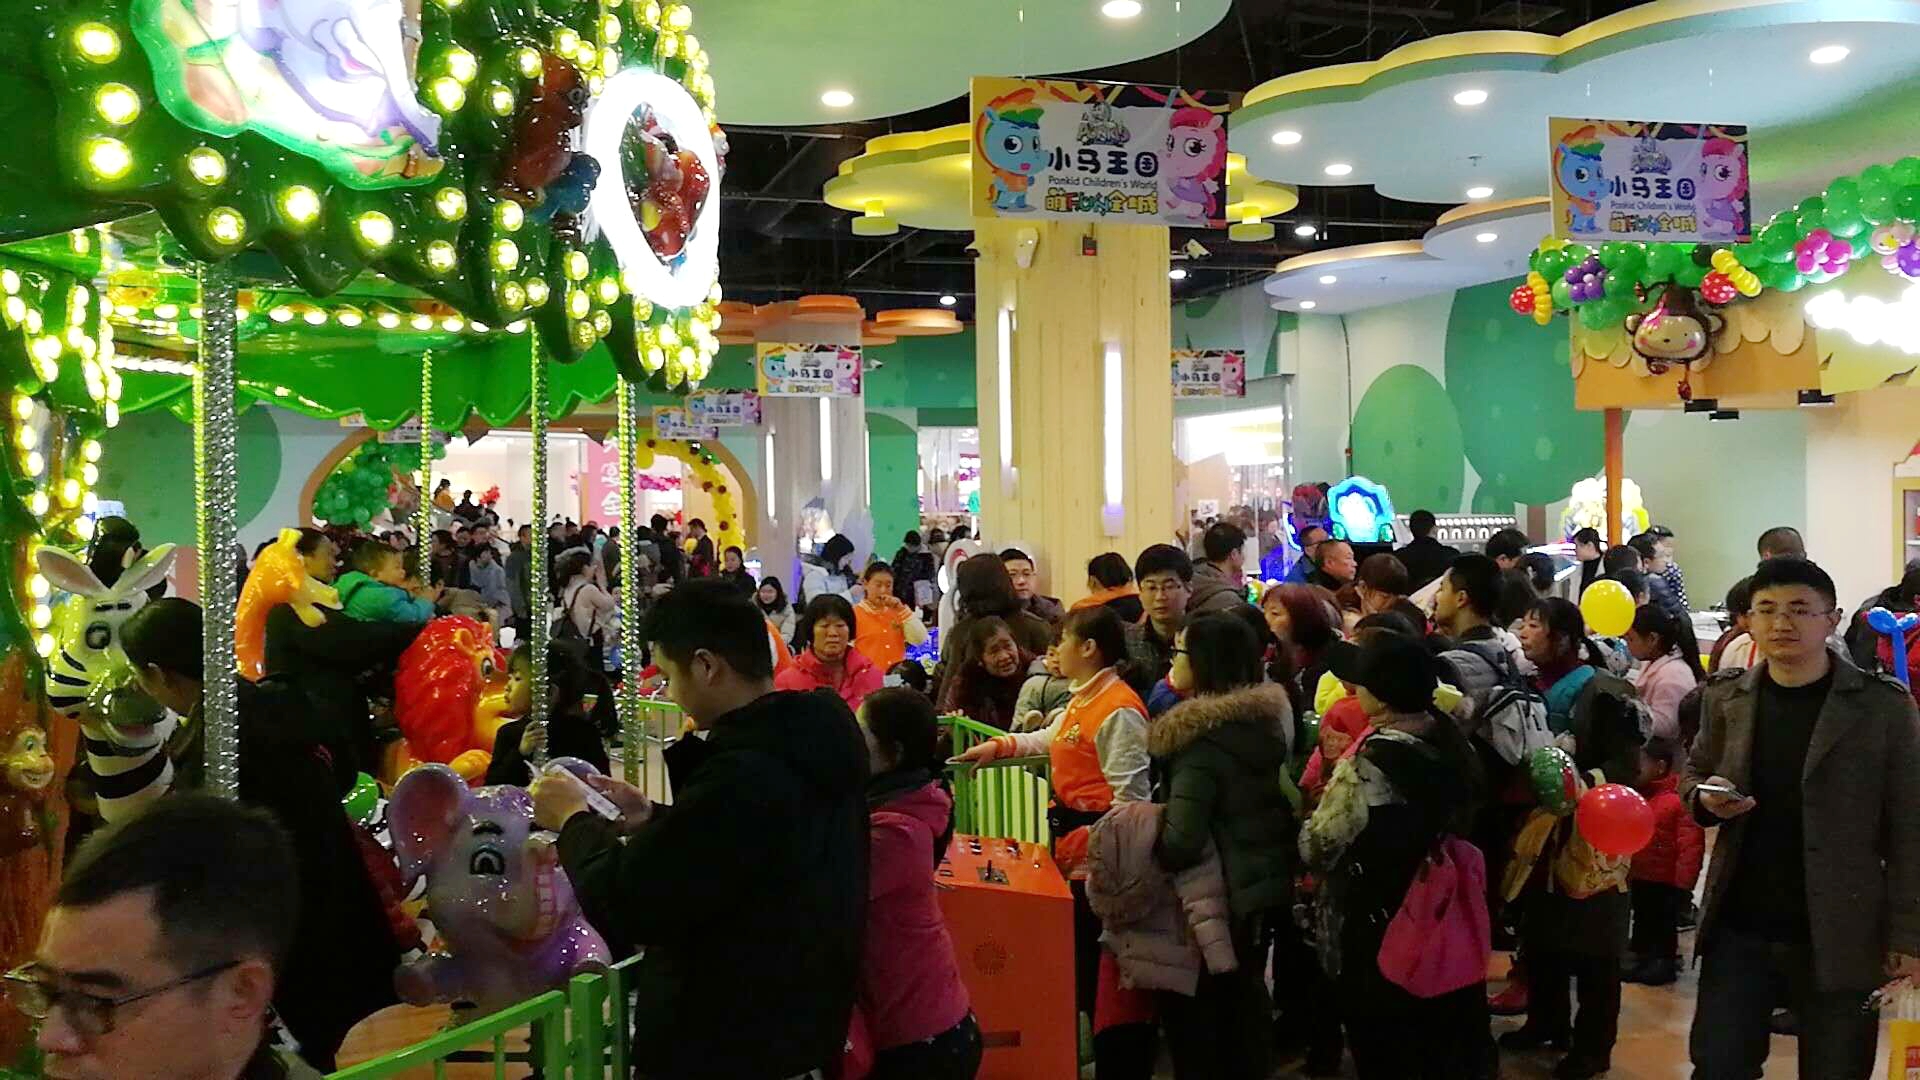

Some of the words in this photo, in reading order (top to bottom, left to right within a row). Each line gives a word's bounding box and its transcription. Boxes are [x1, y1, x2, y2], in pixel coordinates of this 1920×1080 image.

[1048, 146, 1159, 178] 小马王国
[1082, 178, 1128, 189] Children's
[1130, 180, 1158, 191] World
[1609, 175, 1696, 200] 小马王国
